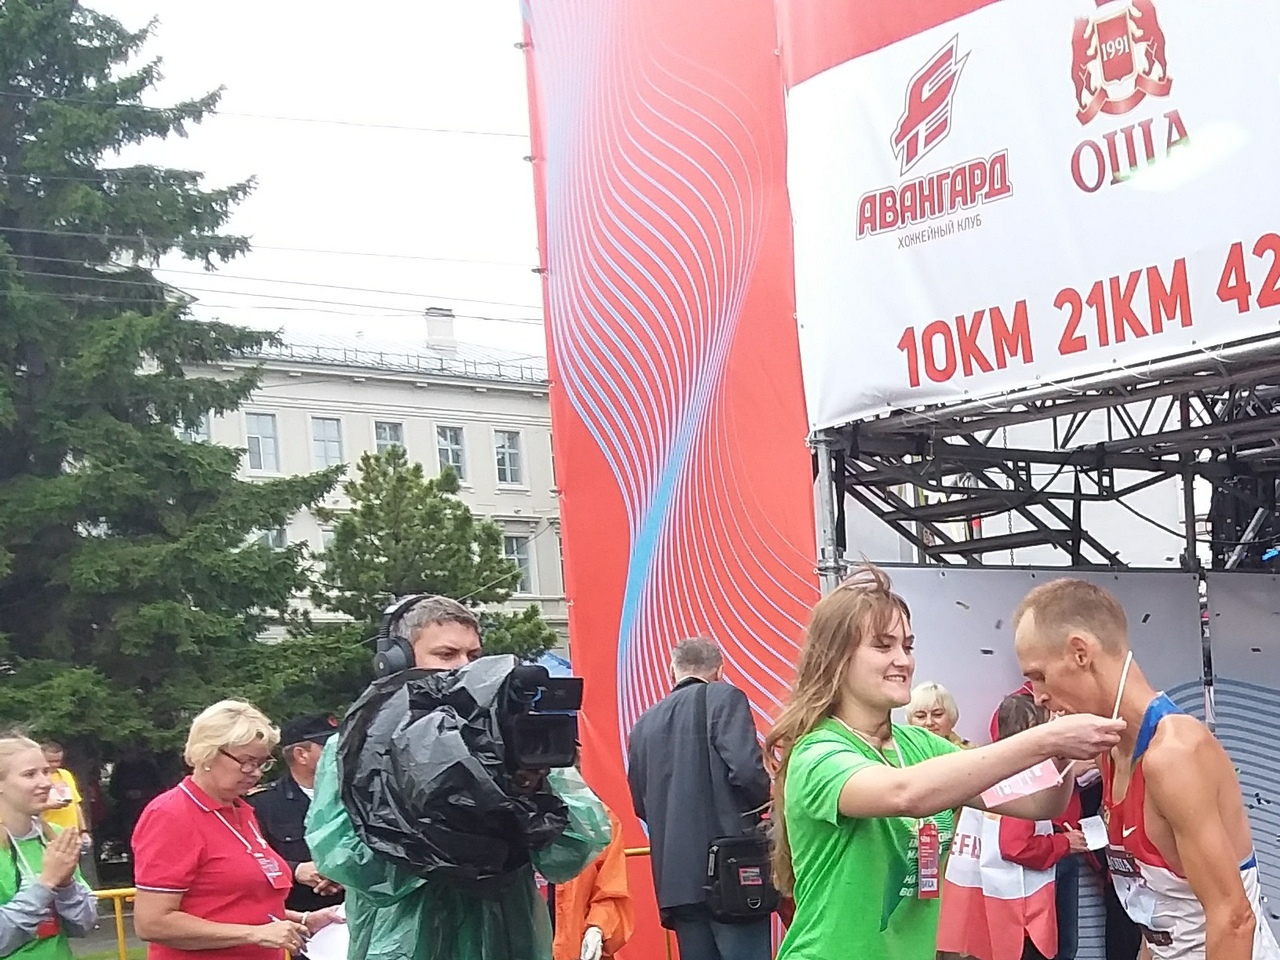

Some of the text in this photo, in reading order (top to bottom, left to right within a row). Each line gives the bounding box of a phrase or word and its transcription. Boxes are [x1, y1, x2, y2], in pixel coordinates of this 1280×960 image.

[1101, 35, 1130, 62] 1991
[857, 150, 1012, 239] АВАНГАРД
[898, 213, 982, 250] ХОККЕЙНЫЙ КЛУБ
